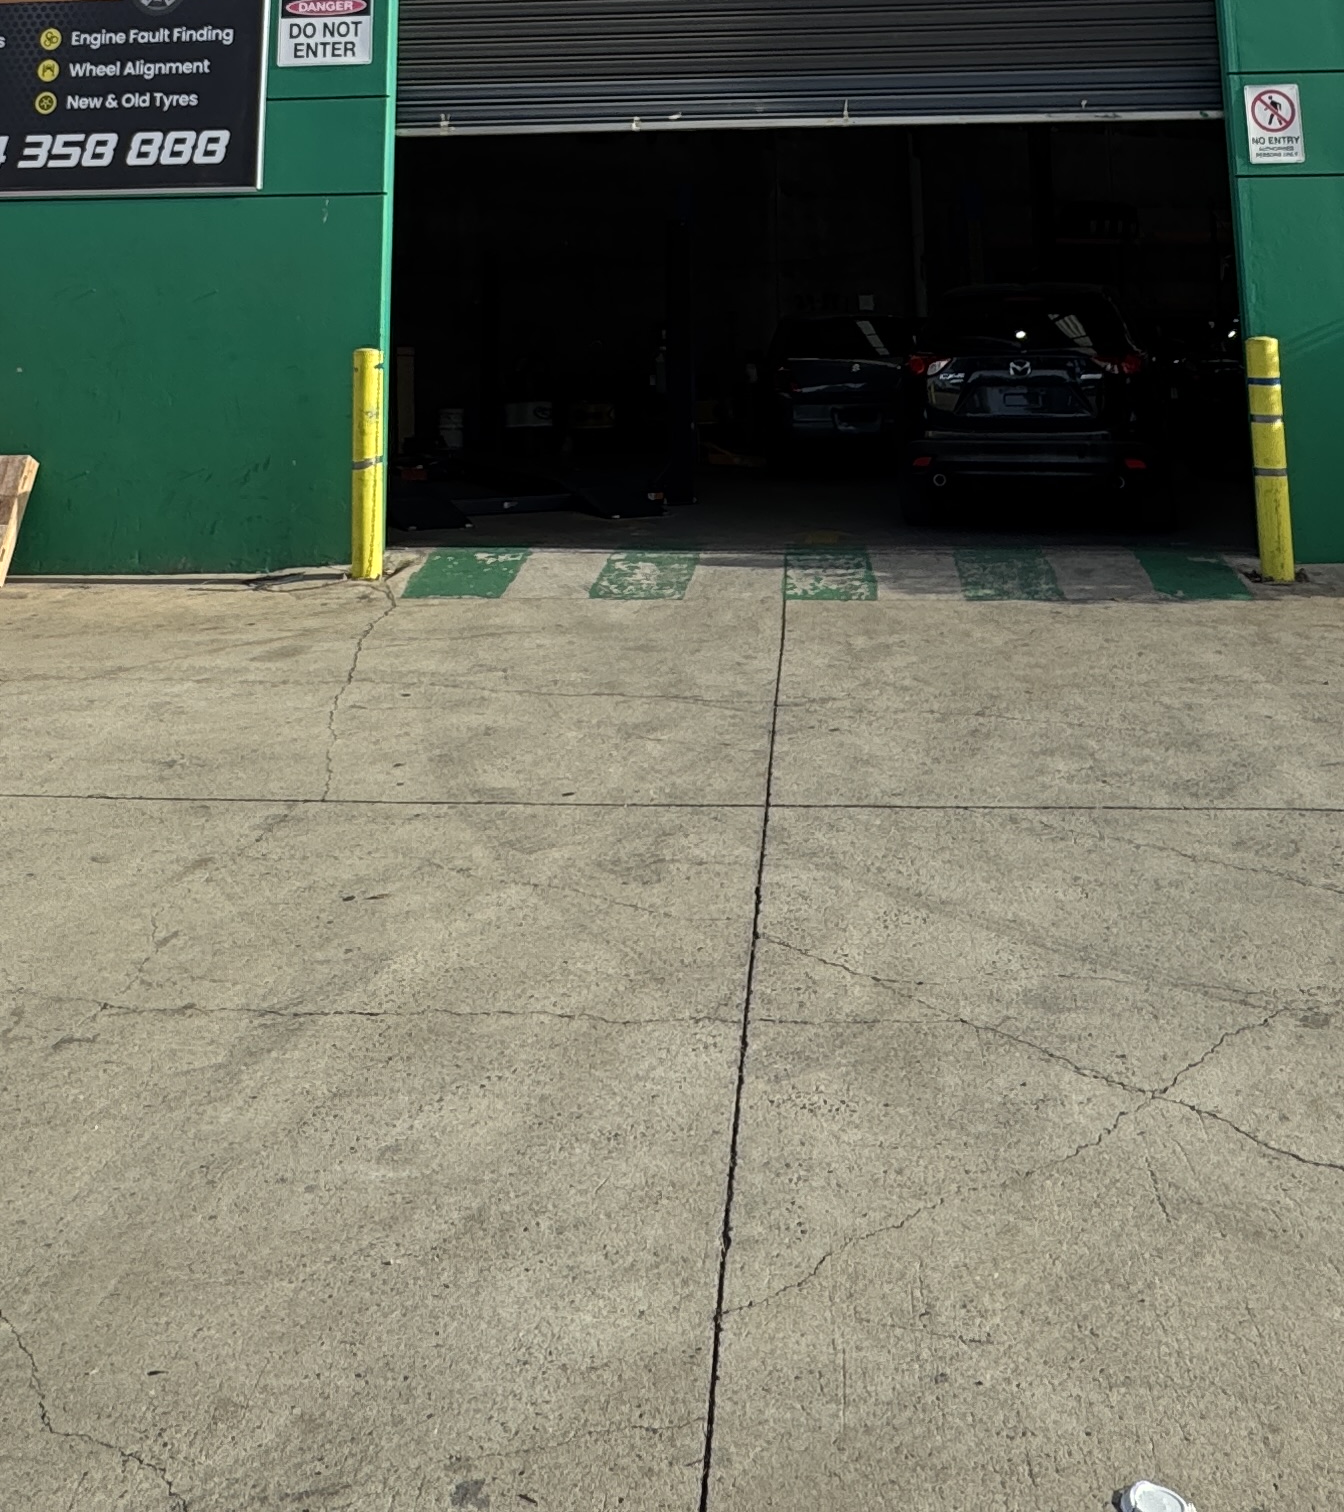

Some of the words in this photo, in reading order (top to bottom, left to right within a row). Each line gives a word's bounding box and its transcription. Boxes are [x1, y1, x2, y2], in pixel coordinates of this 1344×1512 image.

[298, 1, 353, 12] DANGER
[71, 29, 126, 50] Engine
[129, 28, 170, 44] Fault
[173, 25, 234, 46] Finding
[289, 22, 316, 39] DO
[323, 21, 362, 38] NOT
[294, 41, 355, 58] ENTER
[69, 61, 121, 77] Wheel
[123, 59, 211, 80] Alignment
[66, 95, 103, 110] New
[105, 94, 119, 109] &
[121, 92, 150, 108] Old
[153, 93, 198, 112] Tyres
[17, 133, 119, 168] 358
[126, 129, 231, 166] 888
[1252, 136, 1265, 145] NO
[1268, 136, 1300, 145] ENTRY
